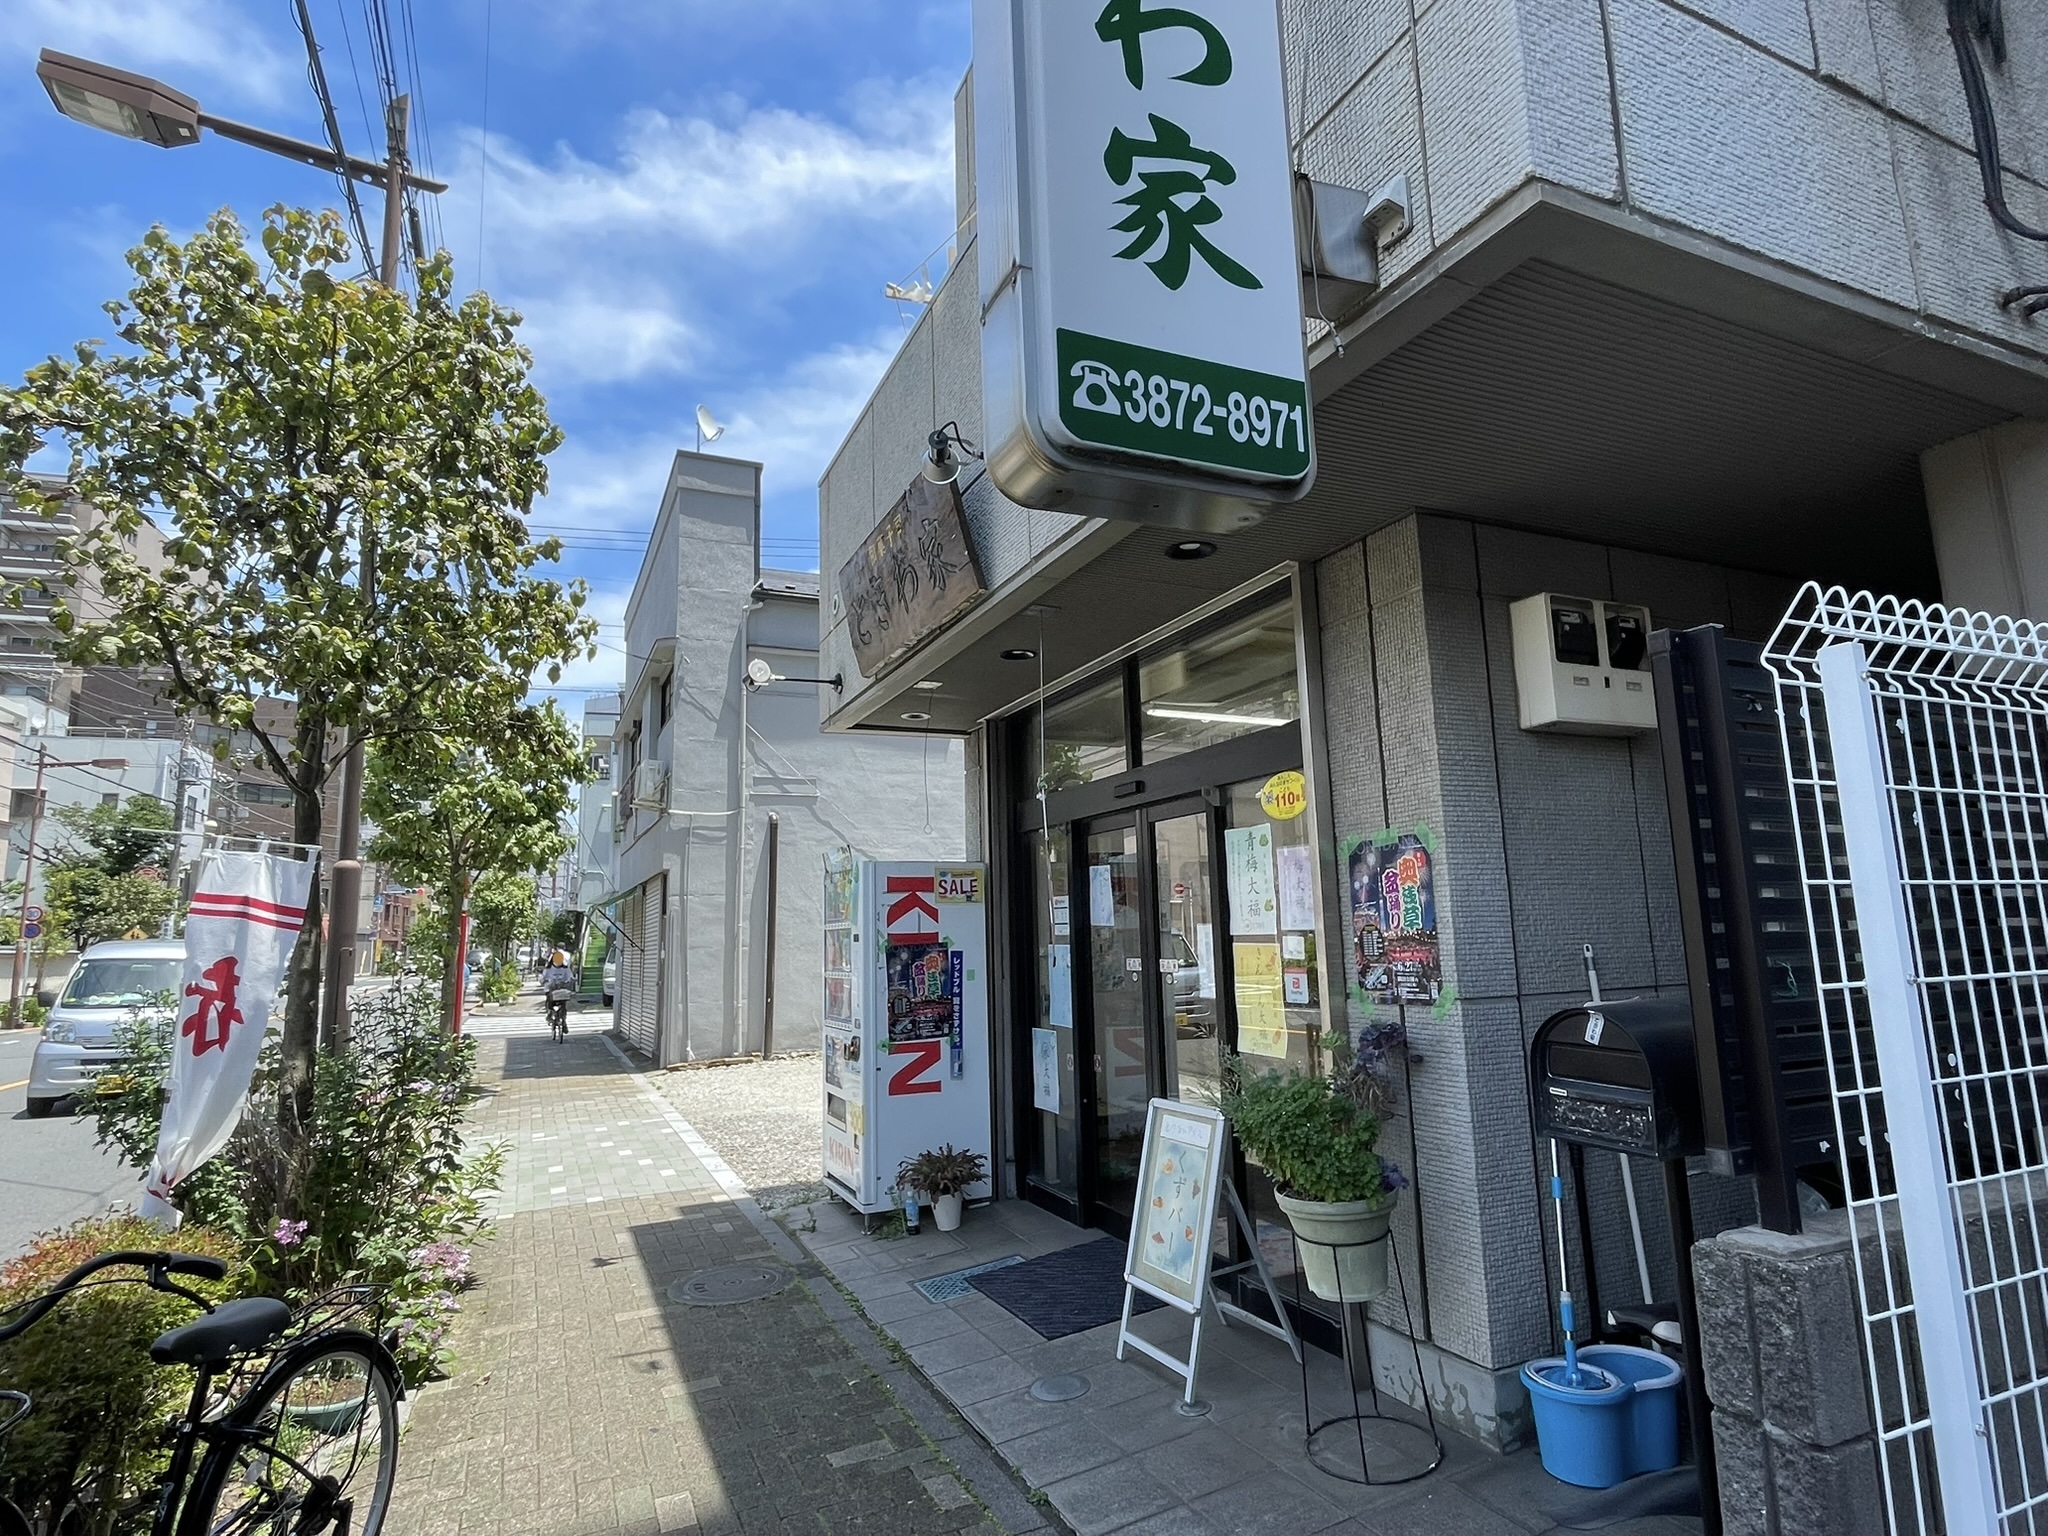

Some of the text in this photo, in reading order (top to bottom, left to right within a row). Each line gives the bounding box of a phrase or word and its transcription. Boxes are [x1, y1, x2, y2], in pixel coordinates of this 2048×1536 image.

[1123, 369, 1305, 453] 3872-8971
[937, 878, 979, 896] SALE
[1244, 830, 1262, 918] 青梅大福
[1397, 856, 1422, 930] 奥浅草
[829, 1136, 855, 1176] KIRIN
